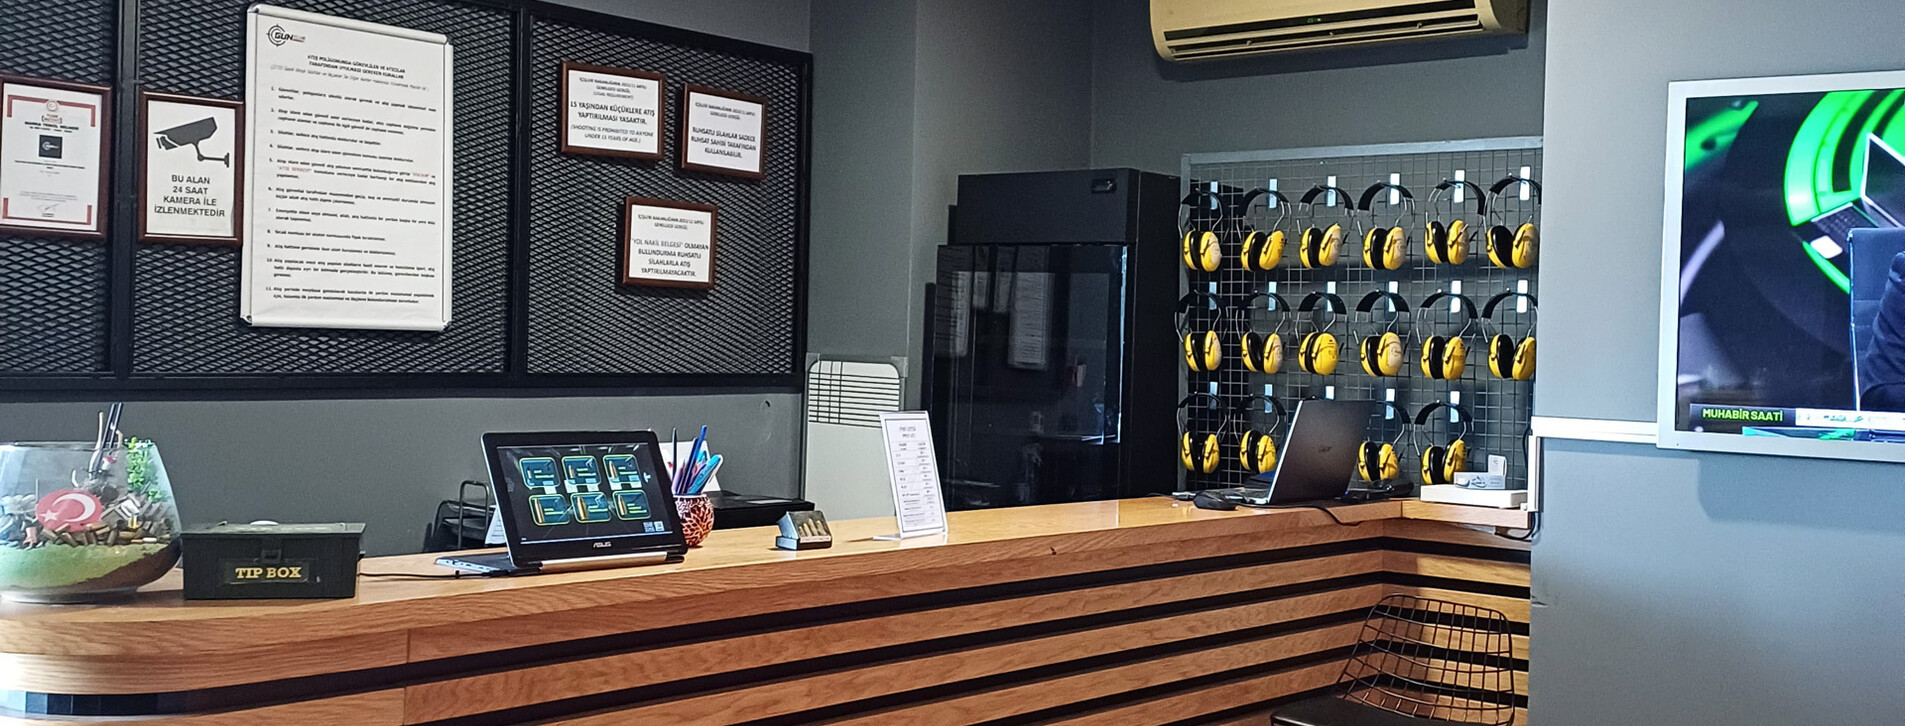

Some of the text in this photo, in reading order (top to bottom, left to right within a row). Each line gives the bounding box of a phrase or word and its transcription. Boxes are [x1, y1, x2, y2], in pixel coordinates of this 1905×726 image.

[274, 32, 294, 42] GUN
[579, 102, 608, 111] YAŞINDAN
[610, 104, 642, 114] KÜÇÜKLERE
[643, 108, 655, 117] ATIŞ
[578, 112, 647, 125] YAPTIRILMASI YASAKTIR.
[739, 134, 756, 142] SADECE
[172, 174, 210, 184] BU ALAN
[185, 186, 208, 194] SAAT
[163, 196, 217, 206] KAMERA İLE
[154, 204, 225, 217] İZLENMEKTEDİR
[648, 258, 679, 266] SİLAHLARLA
[1703, 408, 1783, 422] MUHABİR SAATİ
[235, 566, 302, 579] TIP BOX
